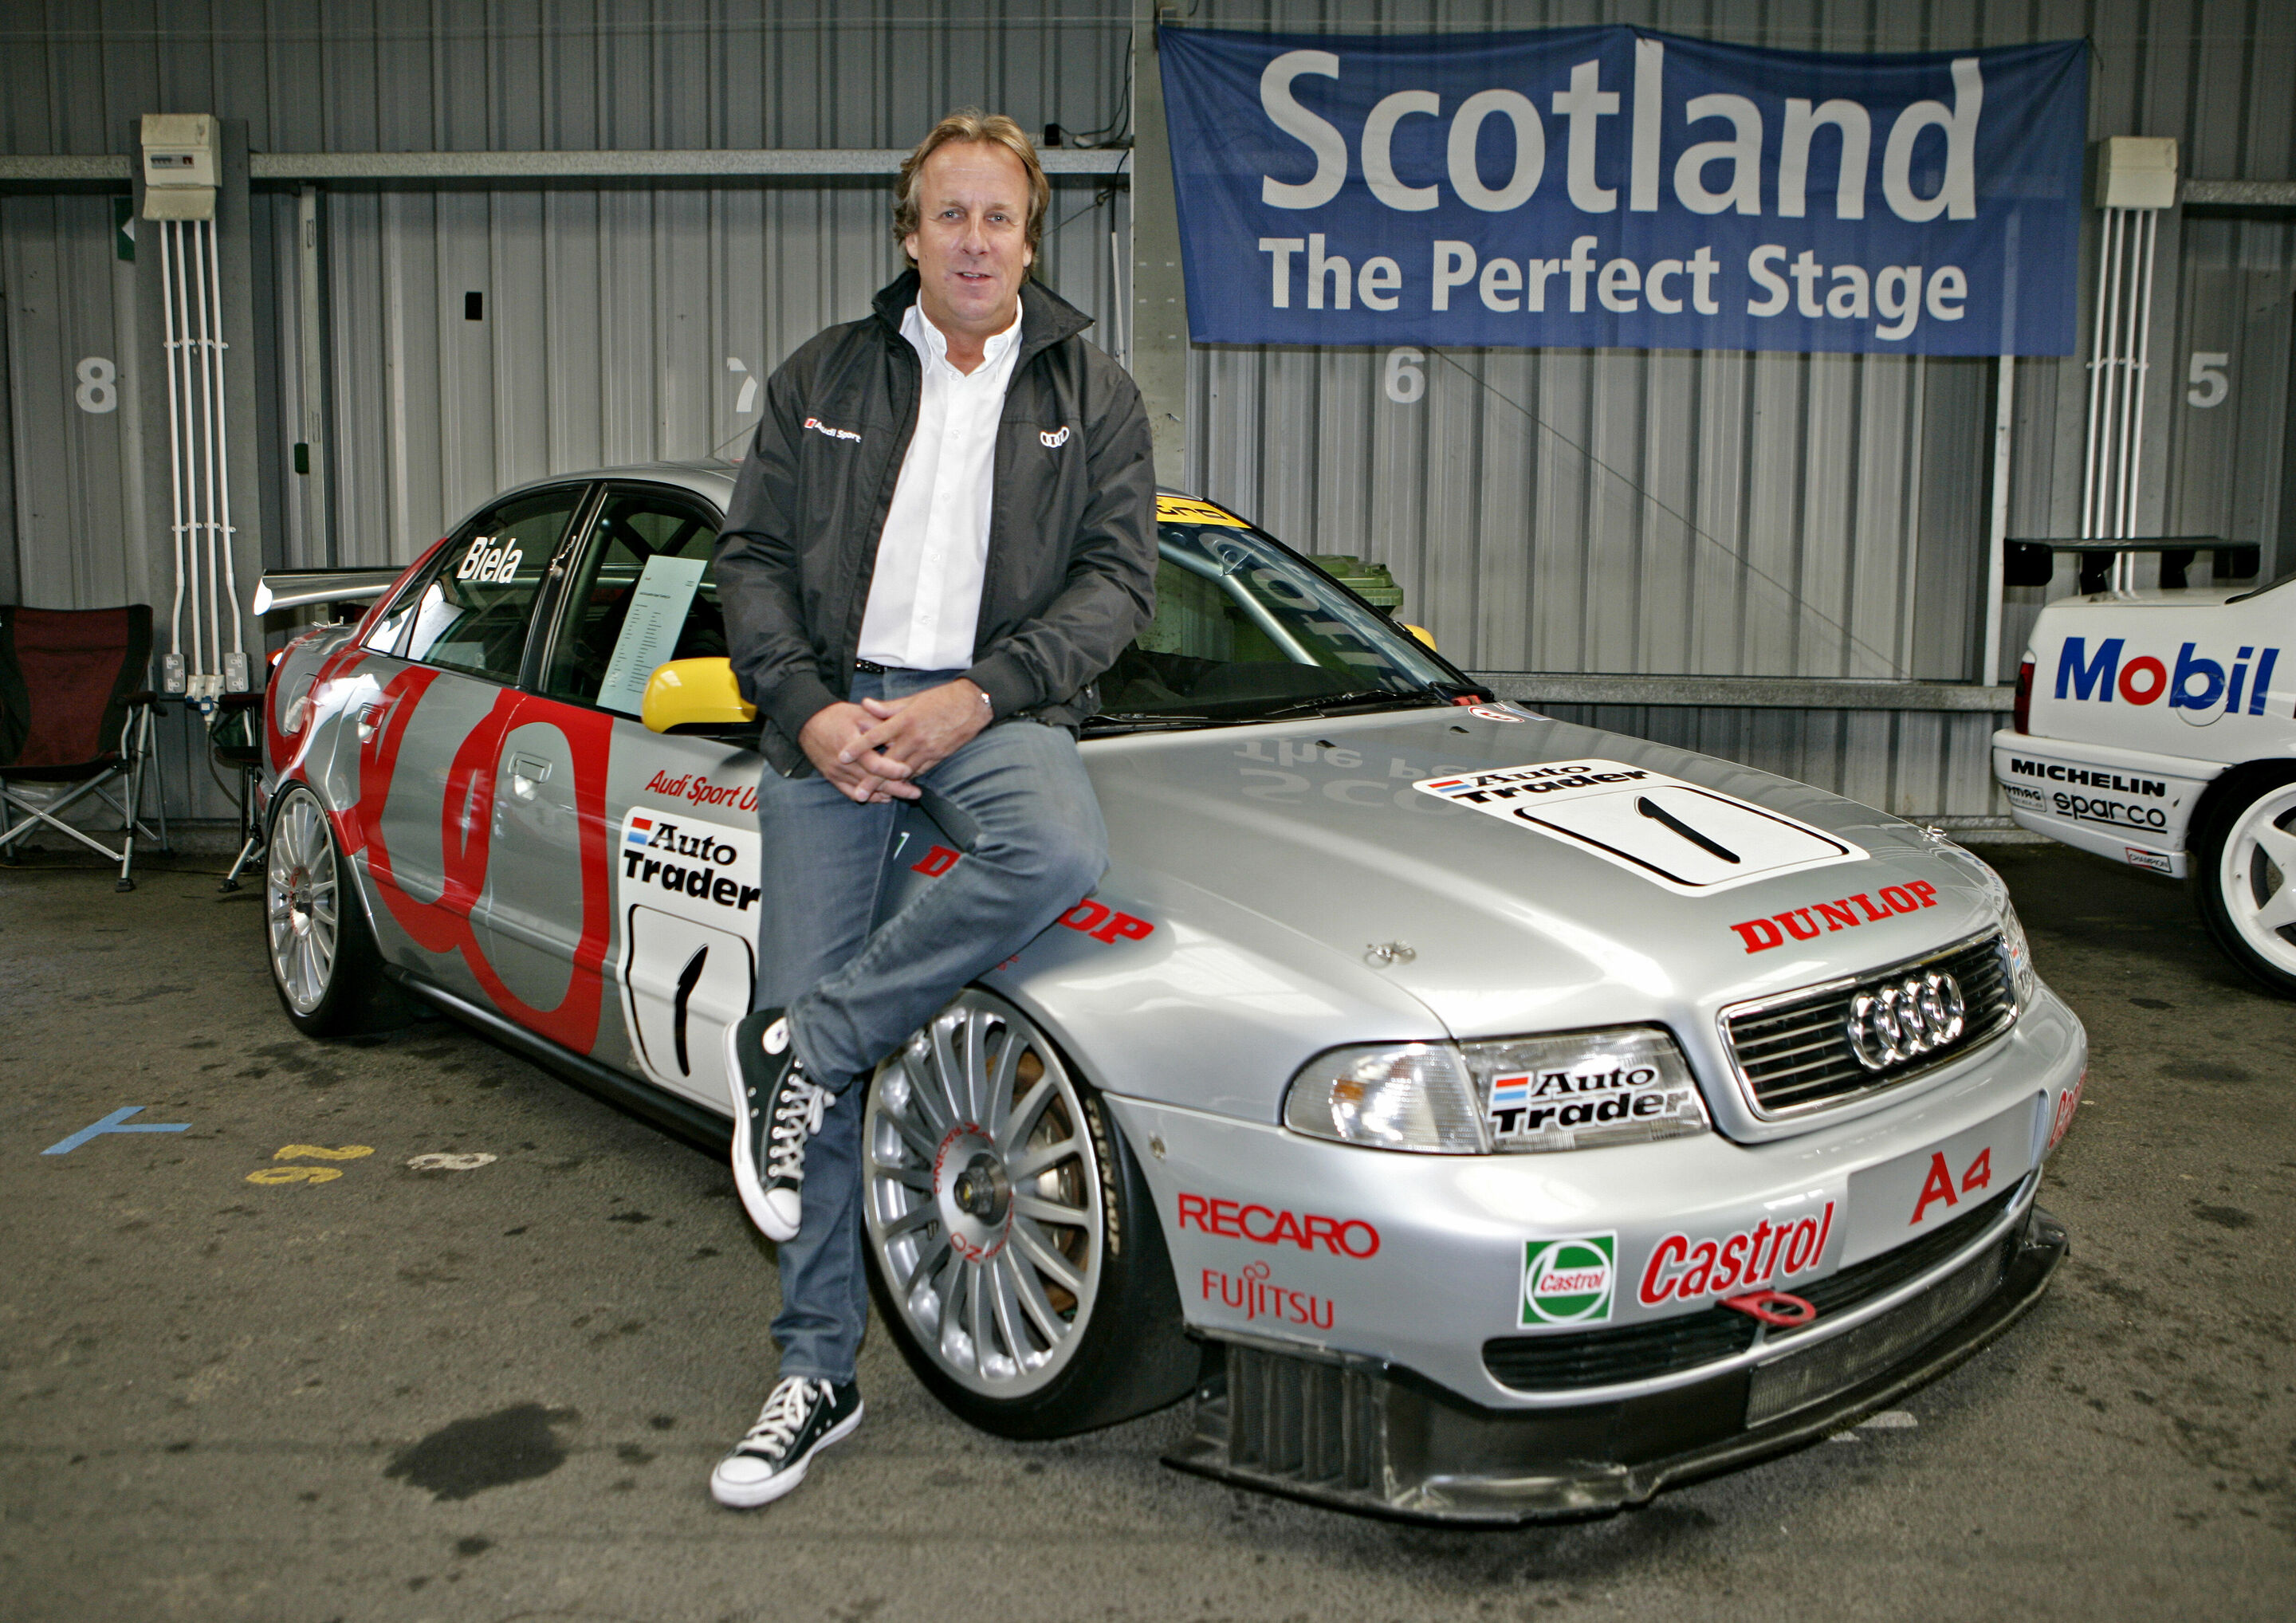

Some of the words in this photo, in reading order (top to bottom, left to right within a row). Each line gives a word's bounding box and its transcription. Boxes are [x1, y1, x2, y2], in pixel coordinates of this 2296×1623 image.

[1260, 36, 1984, 223] Scotland
[1258, 233, 1402, 311] The
[1432, 235, 1720, 316] Perfect
[1747, 244, 1968, 342] Stage
[75, 356, 118, 415] 8
[1383, 347, 1425, 403] 6
[2187, 352, 2229, 408] 5
[814, 421, 837, 438] Audi
[835, 429, 862, 443] Sport
[456, 536, 523, 584] Biela
[2054, 636, 2281, 717] Mobil
[644, 769, 693, 797] Audi
[686, 776, 743, 807] Sport
[1449, 769, 1650, 804] Trader
[1469, 766, 1592, 788] Auto
[2011, 757, 2166, 798] MICHELIN
[1635, 796, 1741, 864] 1
[2053, 792, 2167, 827] sparco
[647, 822, 737, 867] Auto
[623, 848, 762, 912] Trader
[1730, 878, 1938, 954] DUNLOP
[674, 942, 710, 1078] 1
[1530, 1065, 1657, 1098] Auto
[1491, 1091, 1692, 1134] Trader
[1908, 1146, 1991, 1227] A4
[949, 1232, 981, 1264] OZ
[1177, 1193, 1381, 1260] RECARO
[1638, 1201, 1835, 1305] Castrol
[1201, 1262, 1335, 1330] FUJITSU
[1539, 1268, 1606, 1292] Castrol
